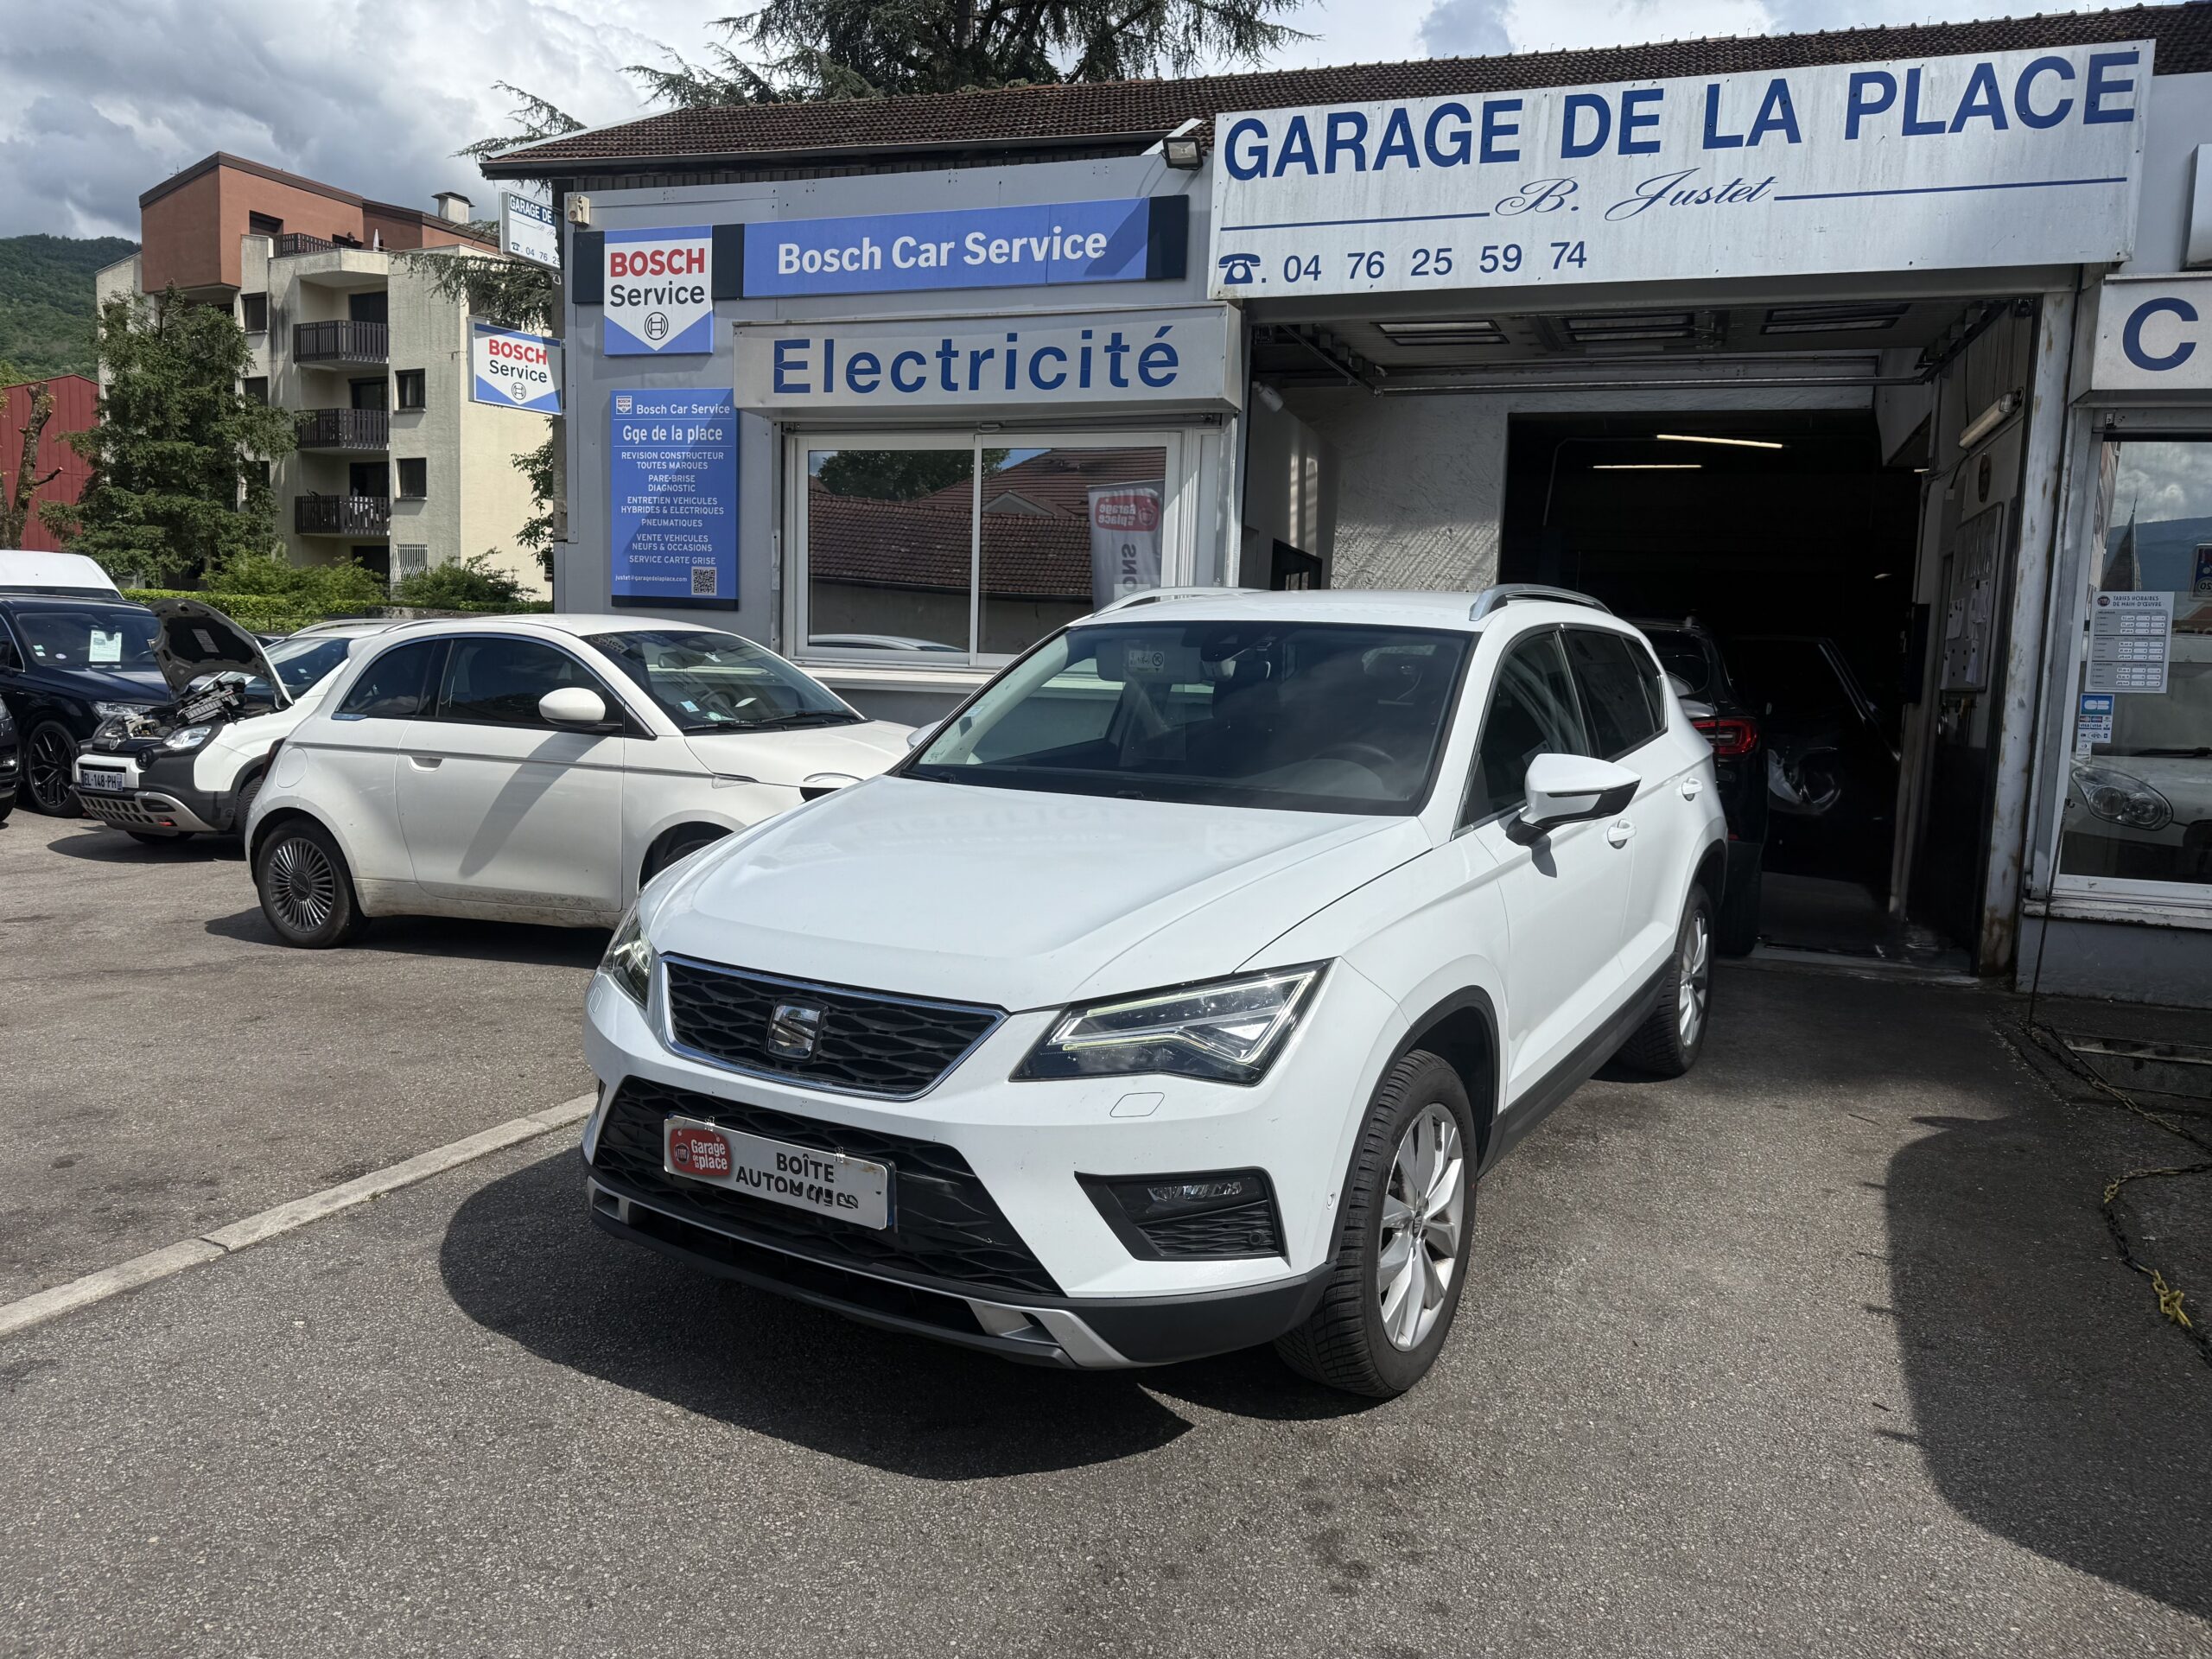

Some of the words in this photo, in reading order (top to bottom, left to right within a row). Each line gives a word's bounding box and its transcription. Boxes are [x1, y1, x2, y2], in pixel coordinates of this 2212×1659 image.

[1224, 99, 1523, 181] GARAGE
[1560, 88, 1664, 159] DE
[1702, 79, 1802, 149] LA
[1845, 51, 2140, 140] PLACE
[1495, 176, 1580, 216] B.
[1605, 168, 1778, 222] Justet
[510, 196, 540, 219] GARAGE
[542, 208, 552, 224] DE
[525, 247, 535, 257] 04
[539, 251, 548, 262] 76
[778, 239, 881, 275] Bosch
[892, 235, 954, 269] Car
[963, 226, 1107, 265] Service
[610, 247, 705, 277] BOSCH
[1283, 255, 1321, 283] 04
[1347, 251, 1384, 280] 76
[1410, 247, 1452, 276] 25
[1479, 243, 1522, 273] 59
[1550, 241, 1587, 270] 74
[610, 280, 705, 307] Service
[489, 339, 547, 365] BOSCH
[773, 325, 1179, 394] Electricité
[489, 359, 547, 383] Service
[636, 404, 667, 415] Bosch
[670, 404, 688, 414] Car
[691, 404, 730, 414] Service
[622, 425, 647, 444] Gge
[652, 425, 667, 441] de
[671, 425, 683, 441] la
[687, 425, 723, 444] place
[648, 474, 696, 483] PARE-BRISE
[620, 505, 660, 514] HYBRIDES
[670, 506, 724, 515] ELECTRIQUES
[627, 496, 671, 505] ENTRETIEN
[641, 518, 702, 527] PNEUMATIQUES
[636, 533, 662, 542] VENTE
[664, 534, 709, 543] VEHICULES
[667, 543, 713, 552] OCCASIONS
[629, 555, 662, 563] SERVICE
[664, 556, 690, 564] CARTE
[692, 556, 716, 565] GRISE
[690, 1139, 726, 1157] Garage
[698, 1154, 728, 1170] place
[776, 1153, 835, 1183] BOÎTE
